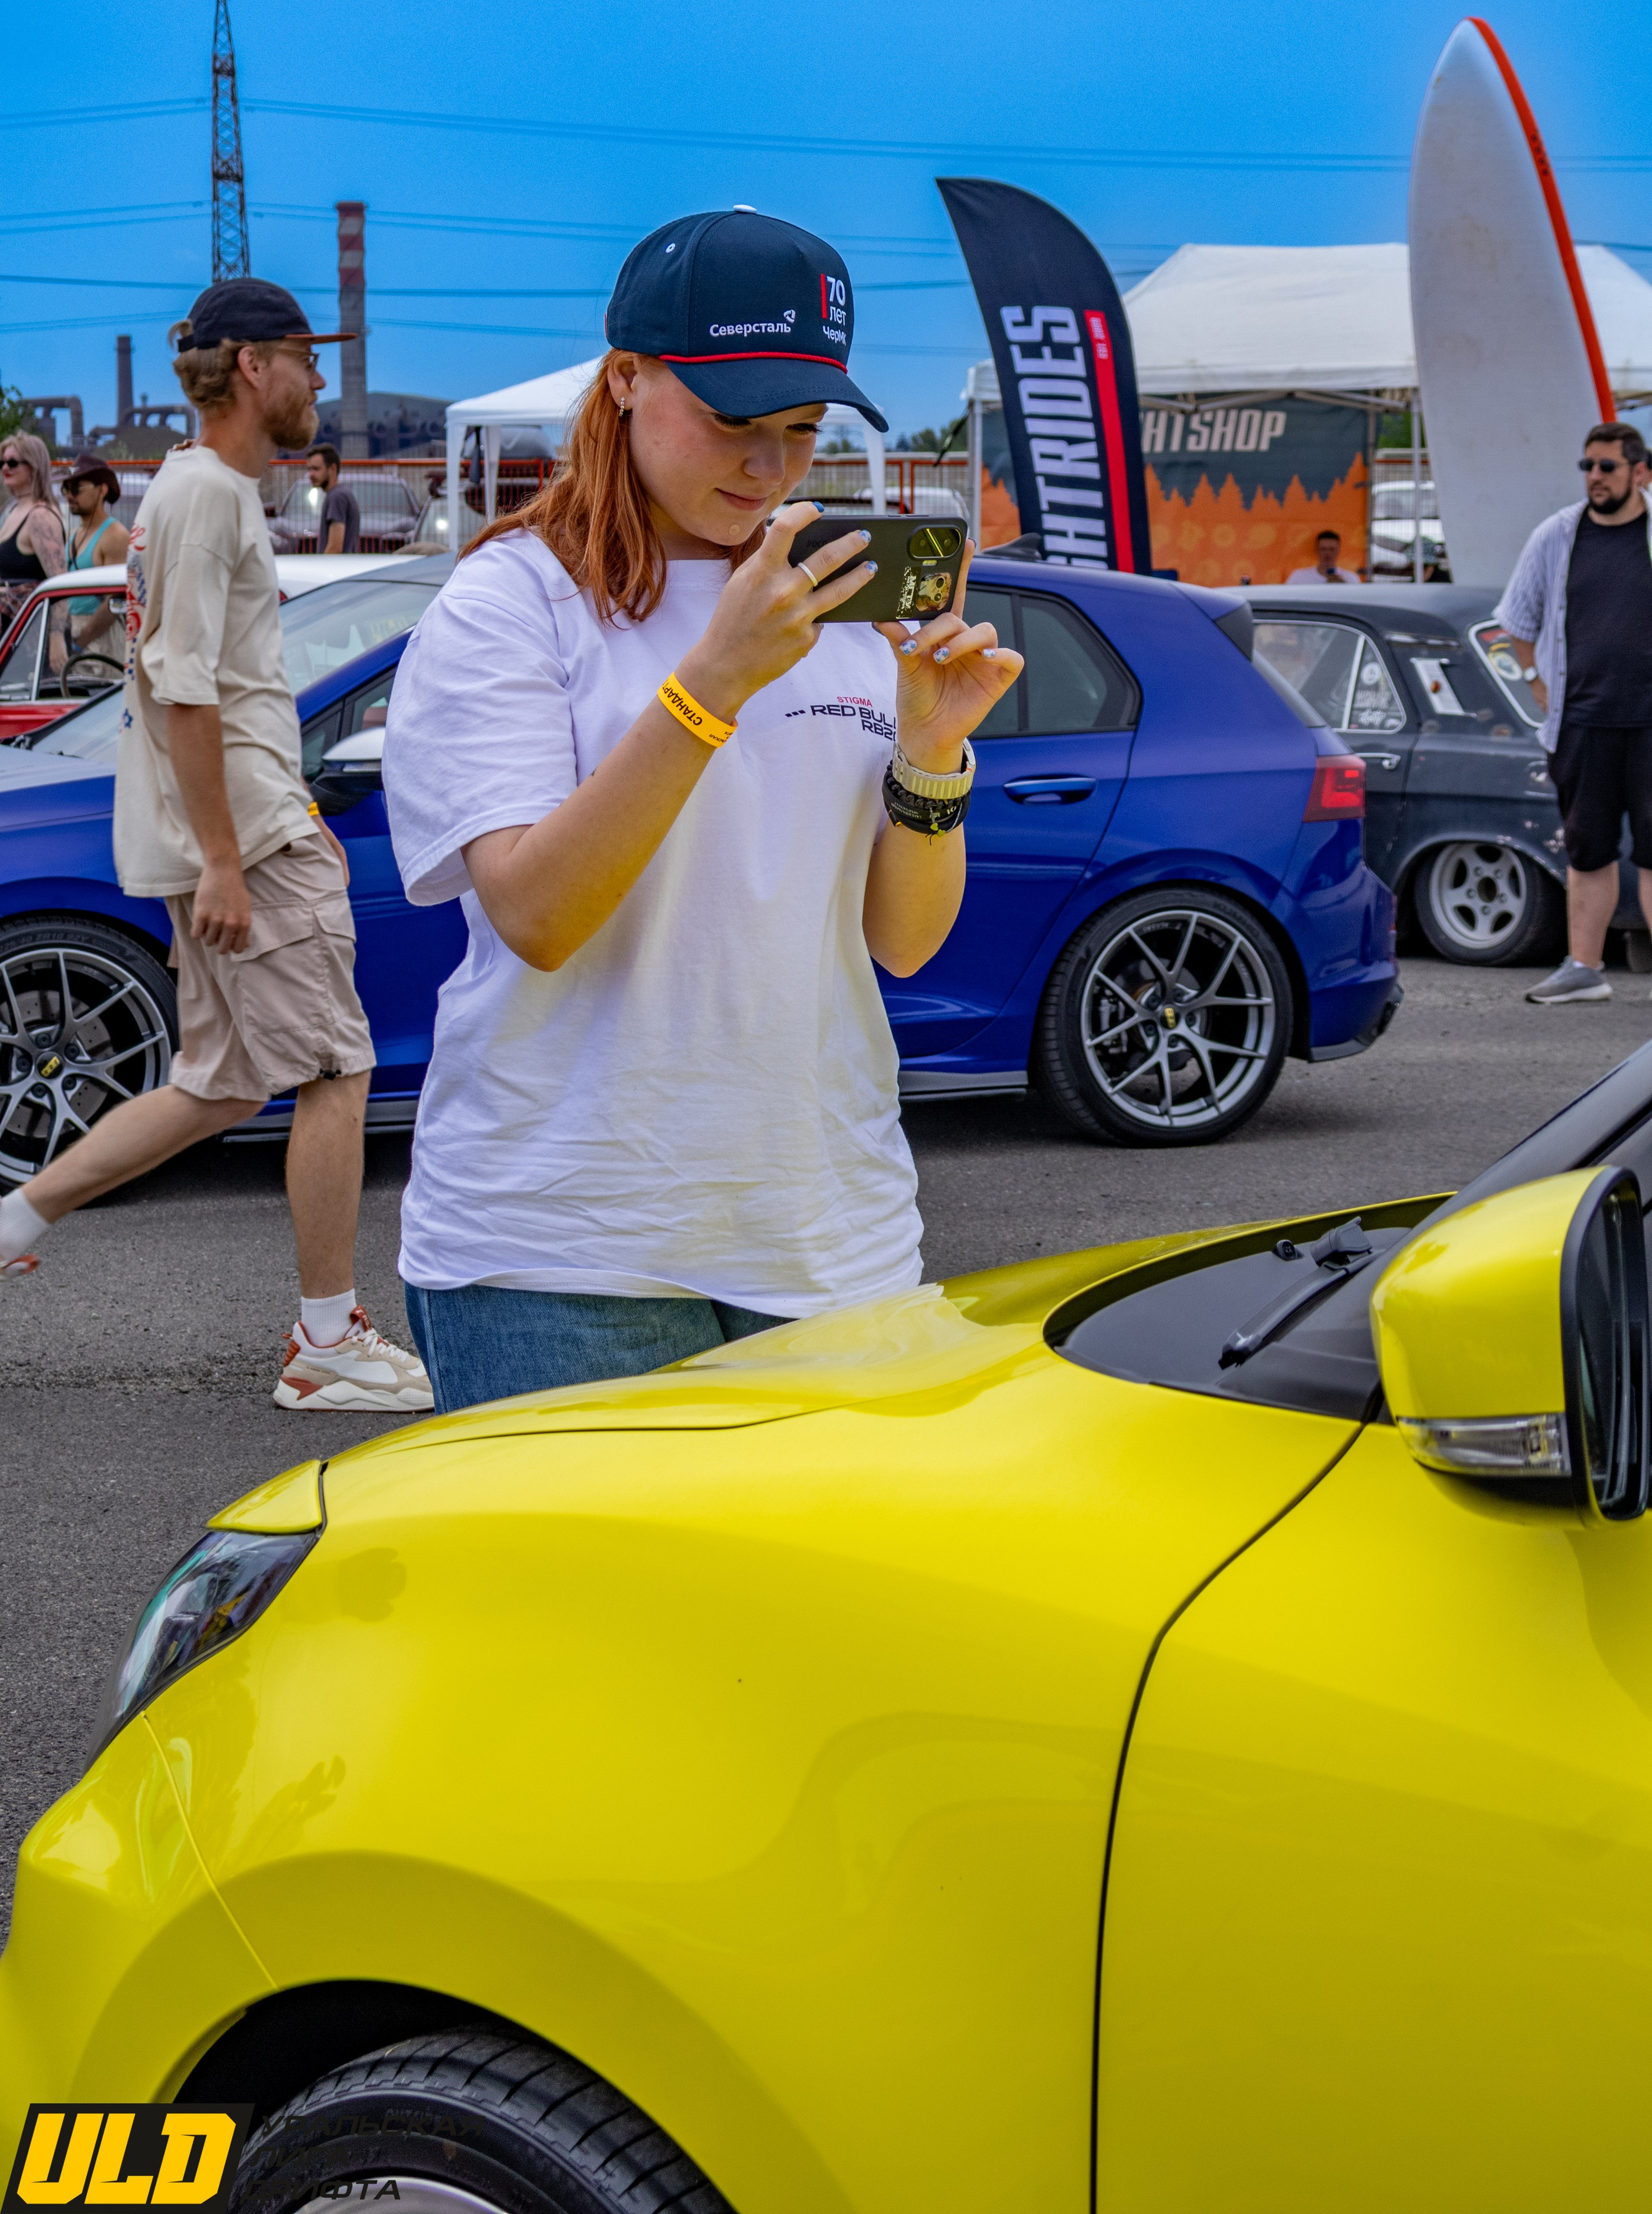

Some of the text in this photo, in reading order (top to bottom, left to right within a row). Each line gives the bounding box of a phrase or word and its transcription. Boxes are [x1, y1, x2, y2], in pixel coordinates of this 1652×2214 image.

[827, 276, 845, 306] 70
[830, 306, 846, 326] лет
[710, 322, 791, 337] Северсталь
[1139, 409, 1287, 454] HTSHOP
[662, 679, 703, 726] СТАНДАРТ
[810, 704, 856, 716] RED
[837, 696, 873, 707] STIGMA
[861, 719, 896, 742] RB2
